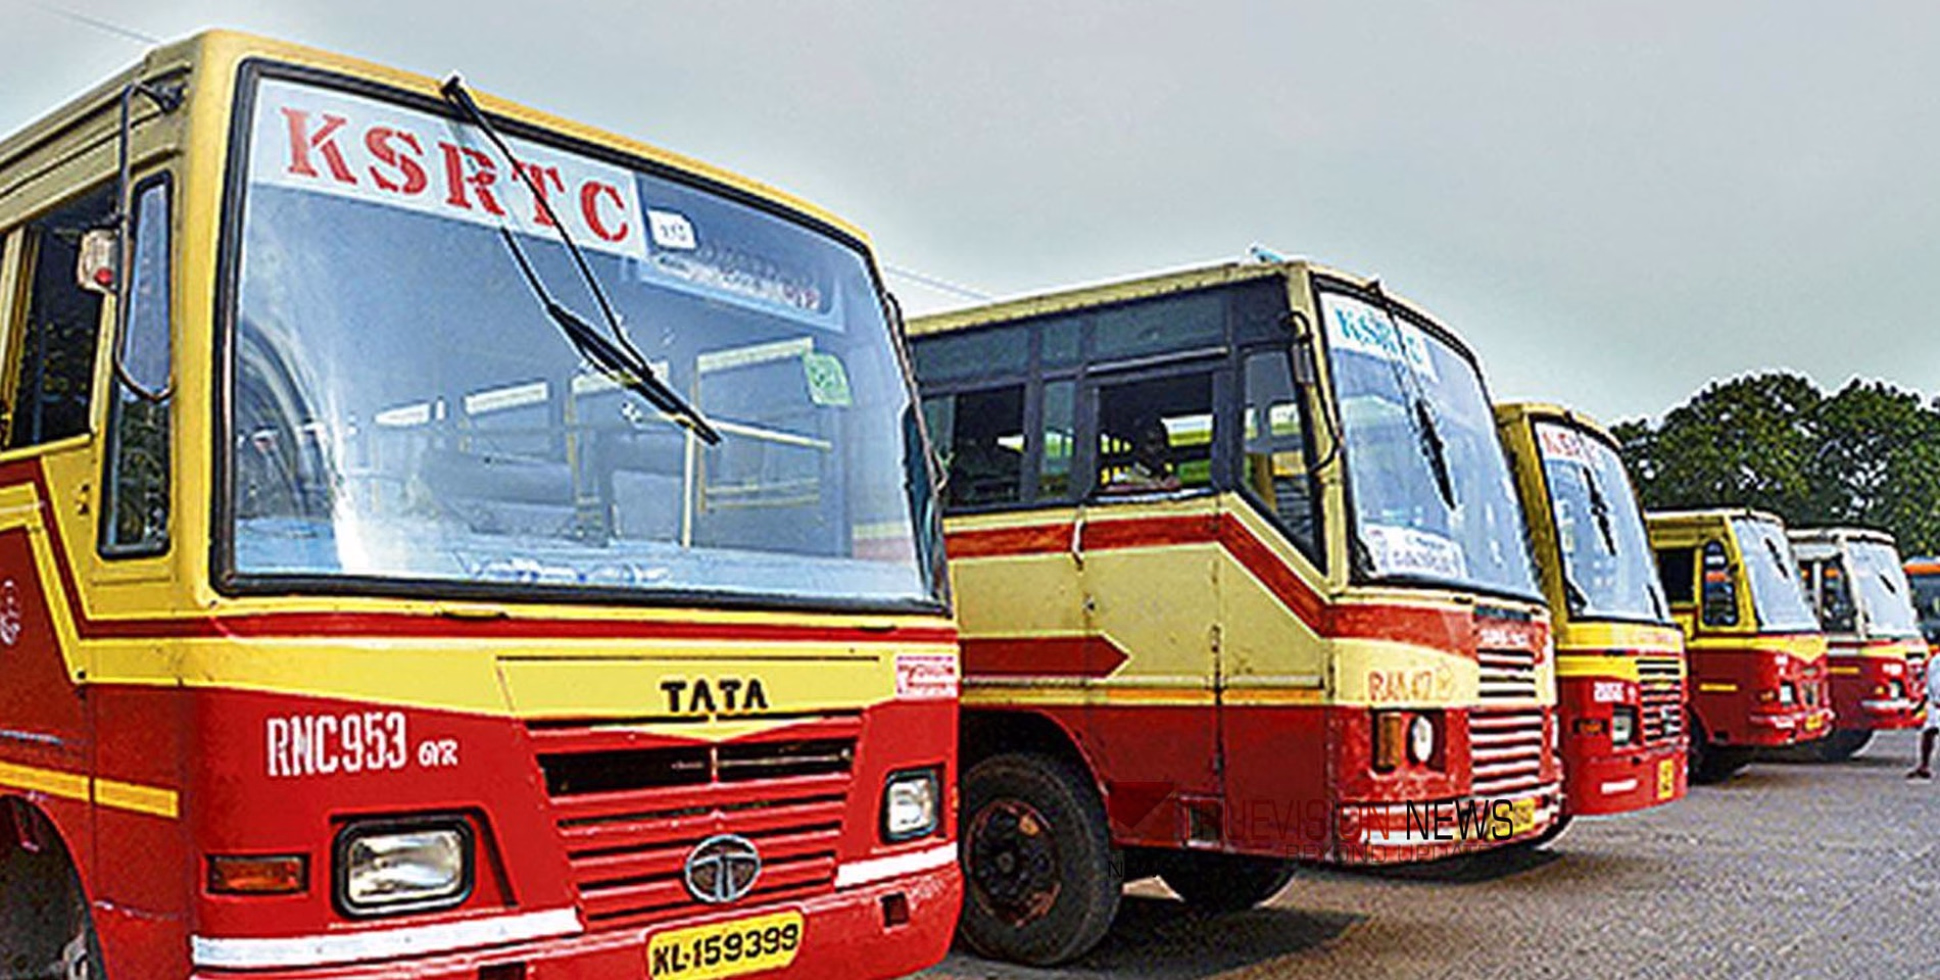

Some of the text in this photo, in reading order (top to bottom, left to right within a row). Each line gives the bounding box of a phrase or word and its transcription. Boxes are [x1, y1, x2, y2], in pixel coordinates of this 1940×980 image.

[280, 106, 629, 243] KSRTC
[1334, 307, 1422, 364] KSRC
[660, 679, 768, 713] TATA
[267, 711, 406, 776] RNC953
